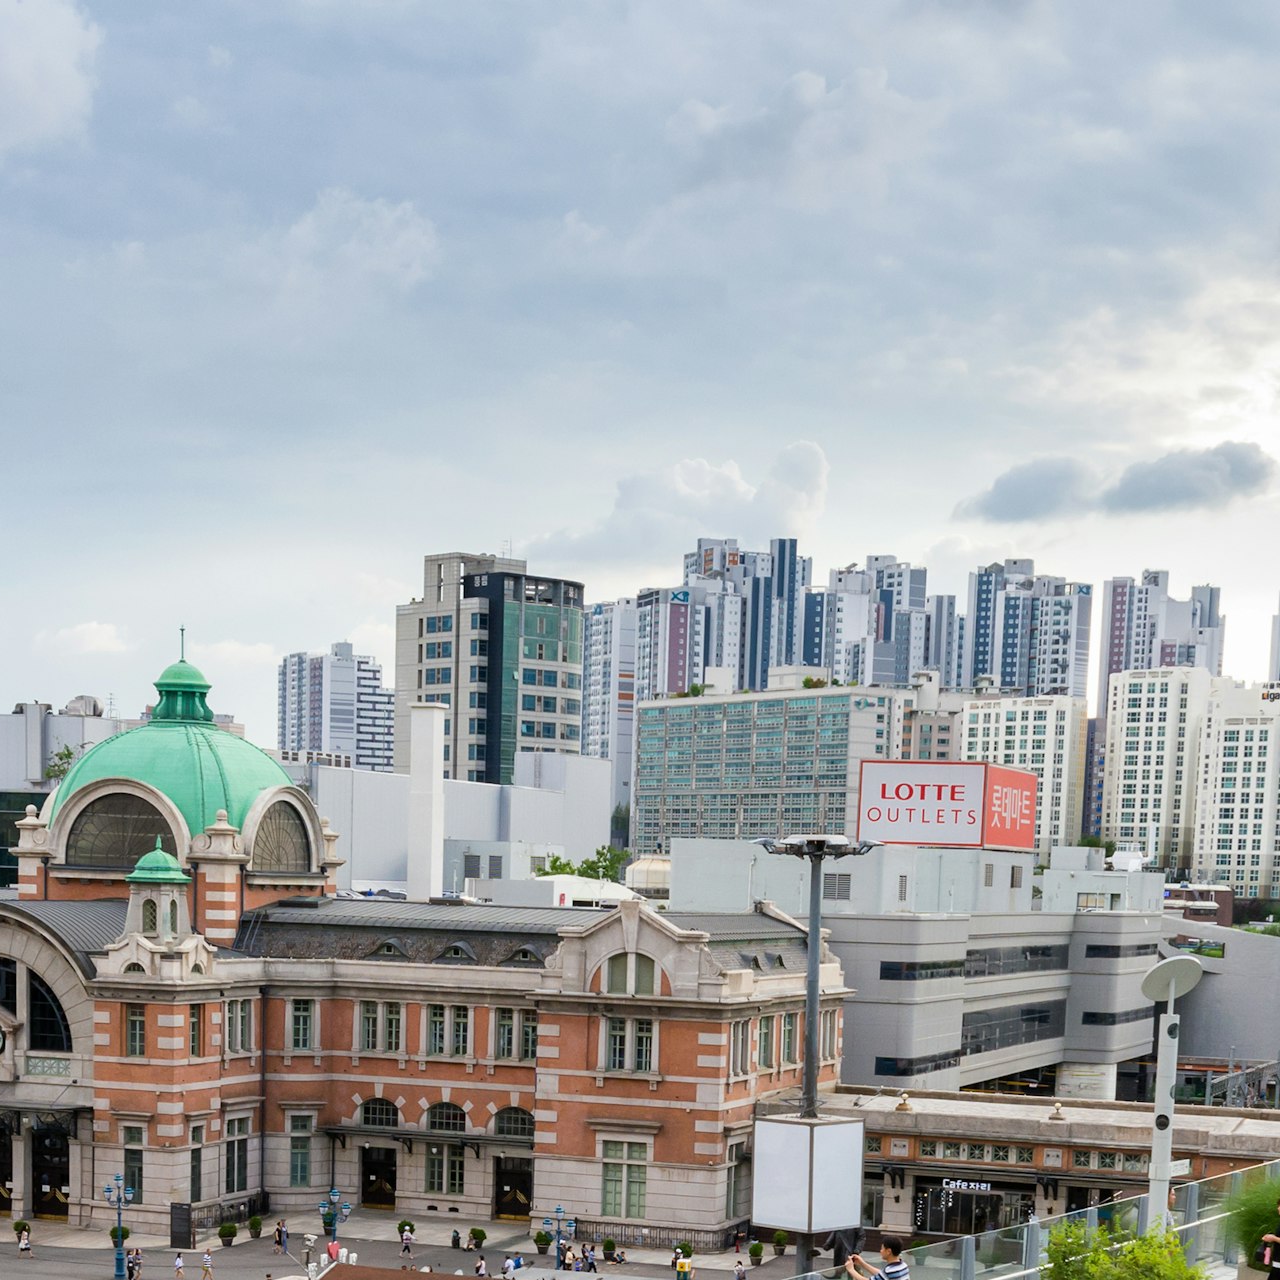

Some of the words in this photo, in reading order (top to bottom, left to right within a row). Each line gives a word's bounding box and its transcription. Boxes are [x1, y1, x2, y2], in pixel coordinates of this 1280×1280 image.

[880, 783, 966, 801] LOTTE
[867, 807, 976, 825] OUTLETS
[991, 785, 1031, 830] 롯데마트
